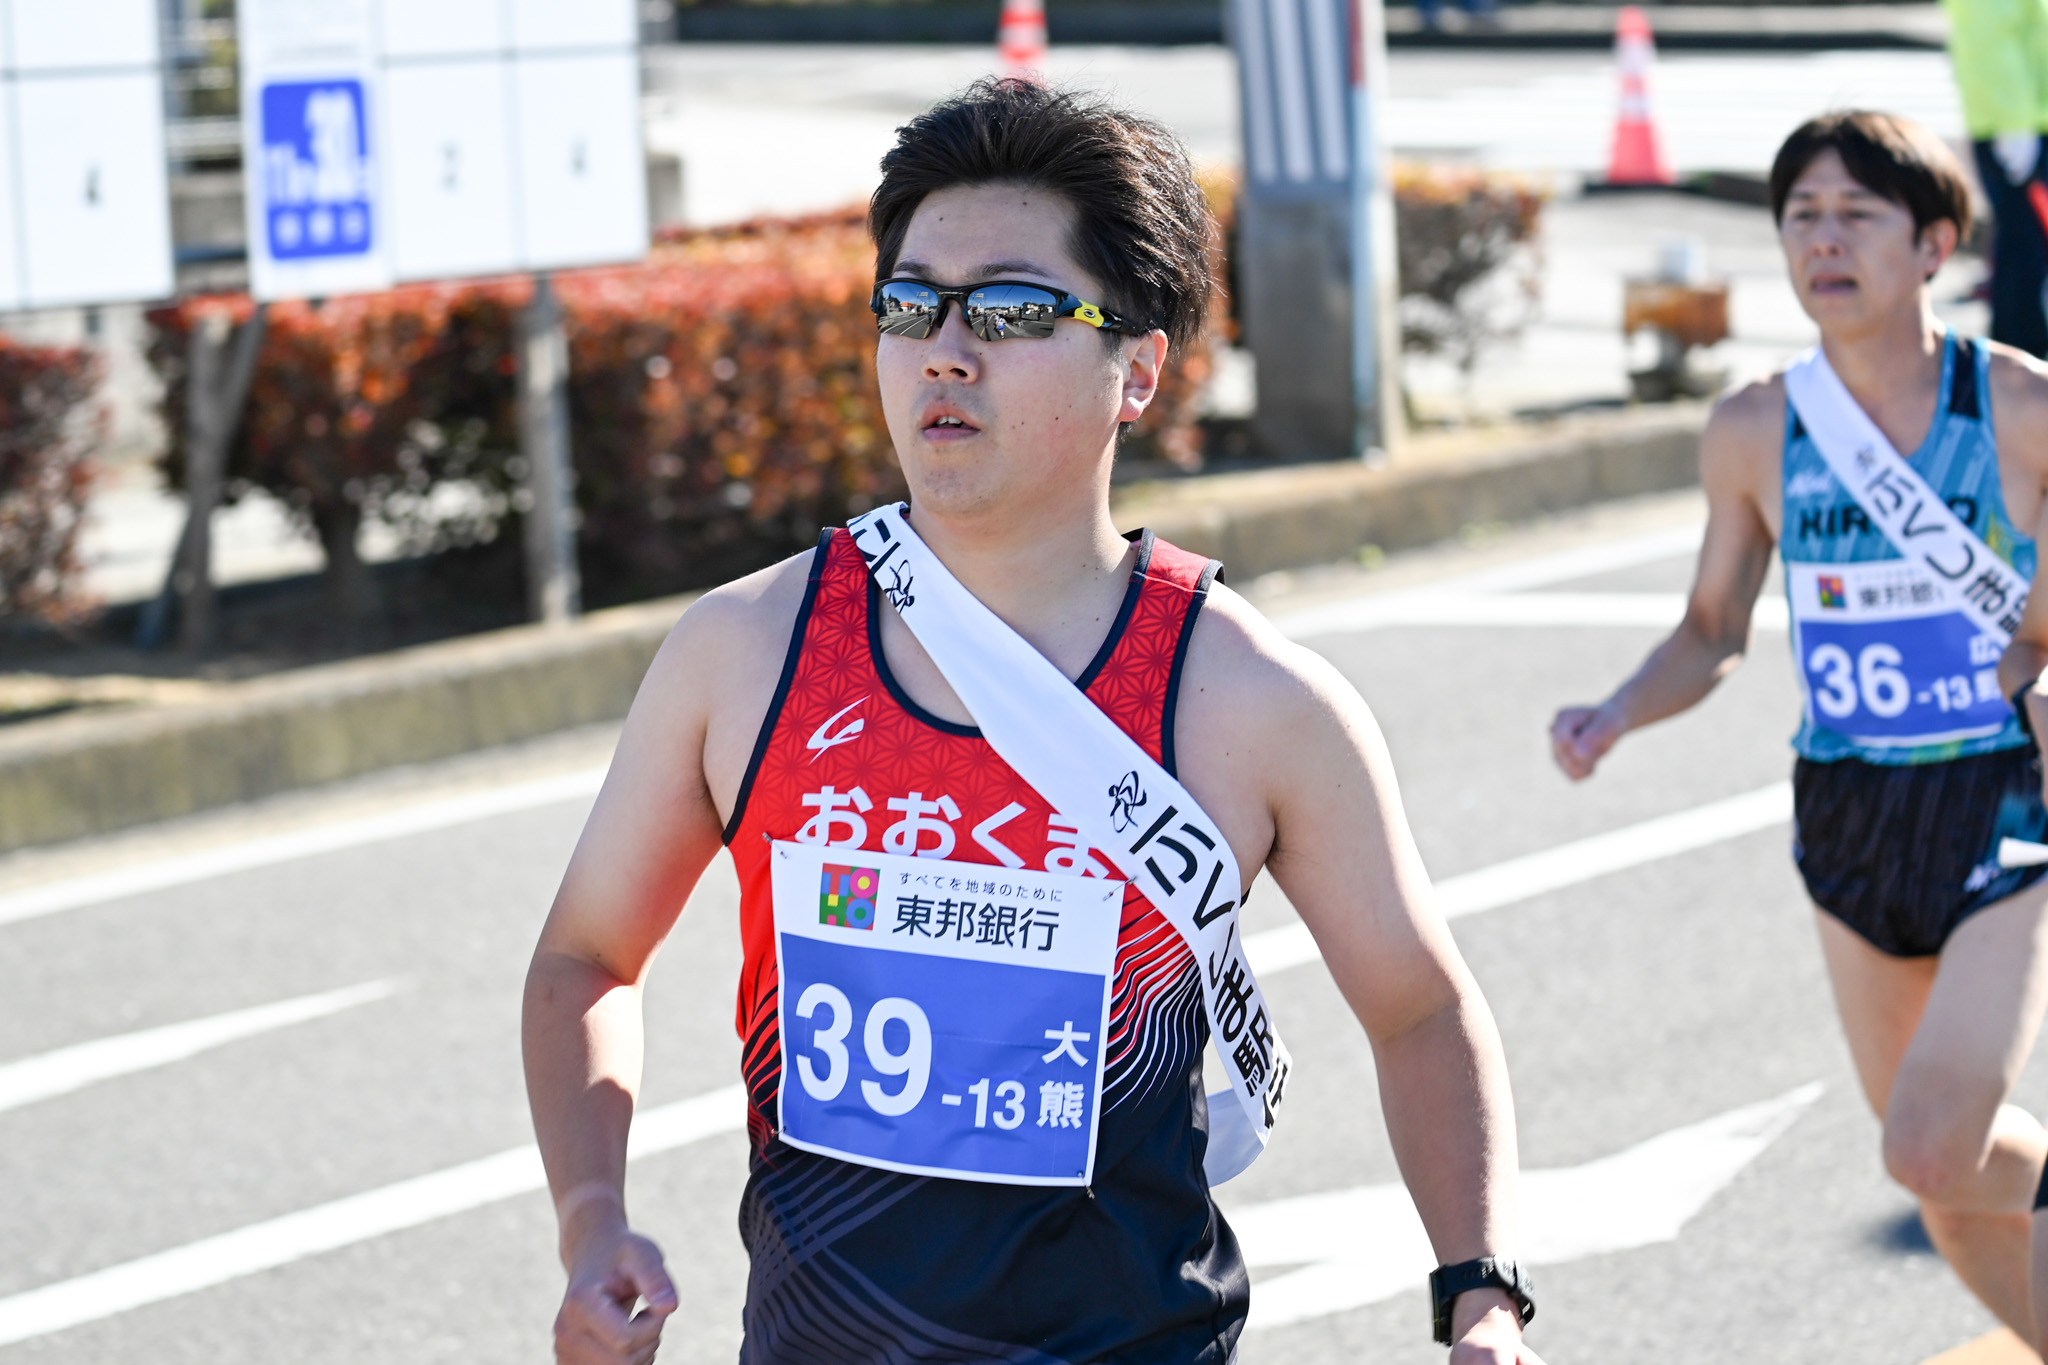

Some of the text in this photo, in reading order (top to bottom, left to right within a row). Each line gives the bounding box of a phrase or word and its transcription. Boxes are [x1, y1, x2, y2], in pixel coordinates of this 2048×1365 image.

[1800, 496, 1977, 541] HIRO
[1860, 581, 1948, 607] 東邦銀
[899, 871, 1063, 902] すべてを地域のために
[892, 893, 1061, 951] 東邦銀行
